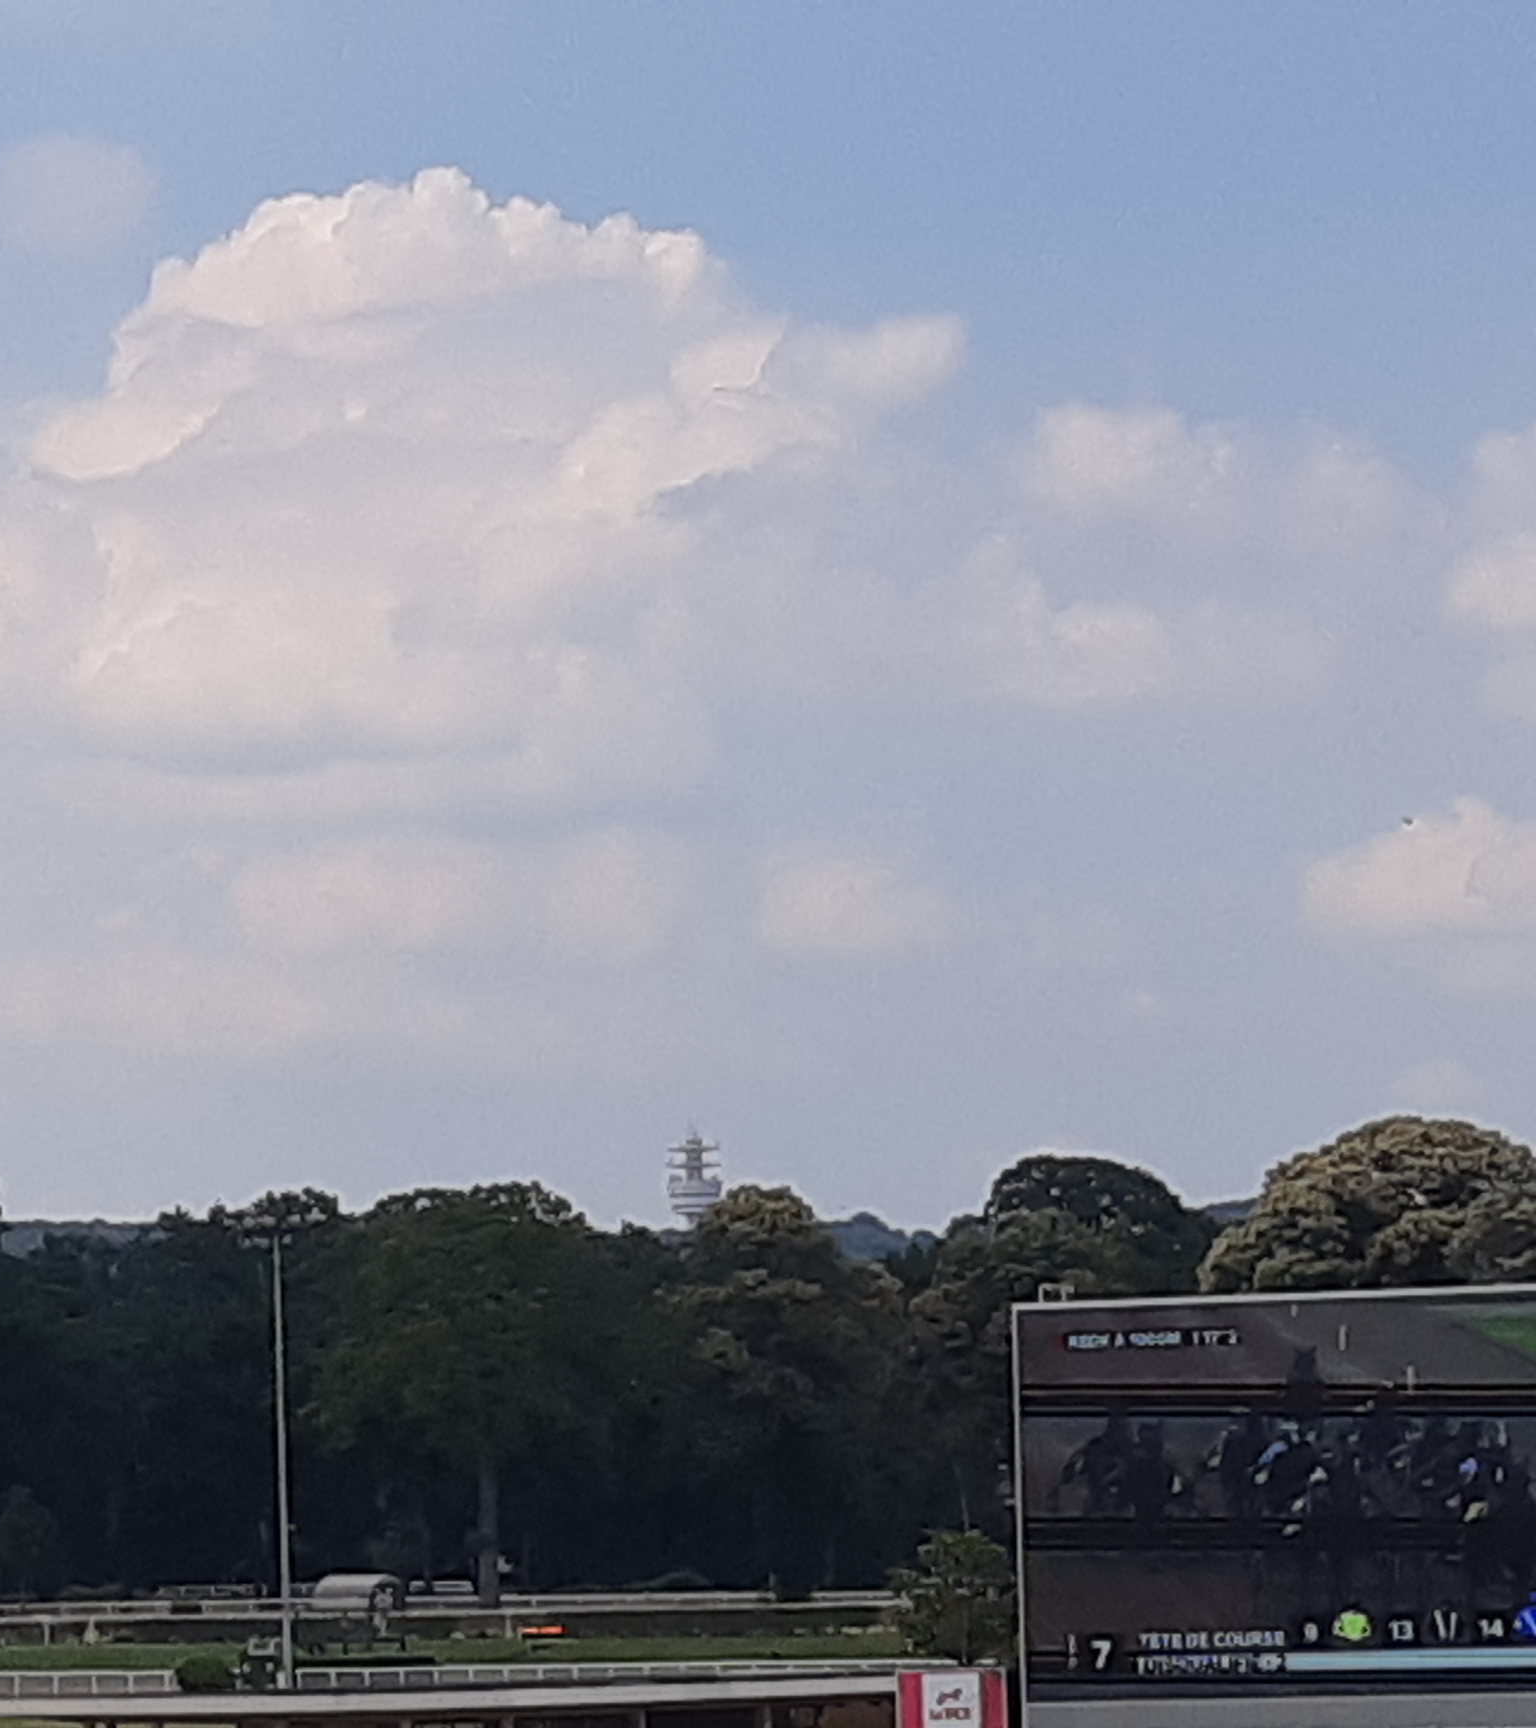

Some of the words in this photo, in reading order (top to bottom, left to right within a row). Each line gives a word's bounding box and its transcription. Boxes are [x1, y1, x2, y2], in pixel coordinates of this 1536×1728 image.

[1388, 1619, 1414, 1641] 13
[1478, 1618, 1504, 1637] 14
[1090, 1639, 1112, 1670] 7
